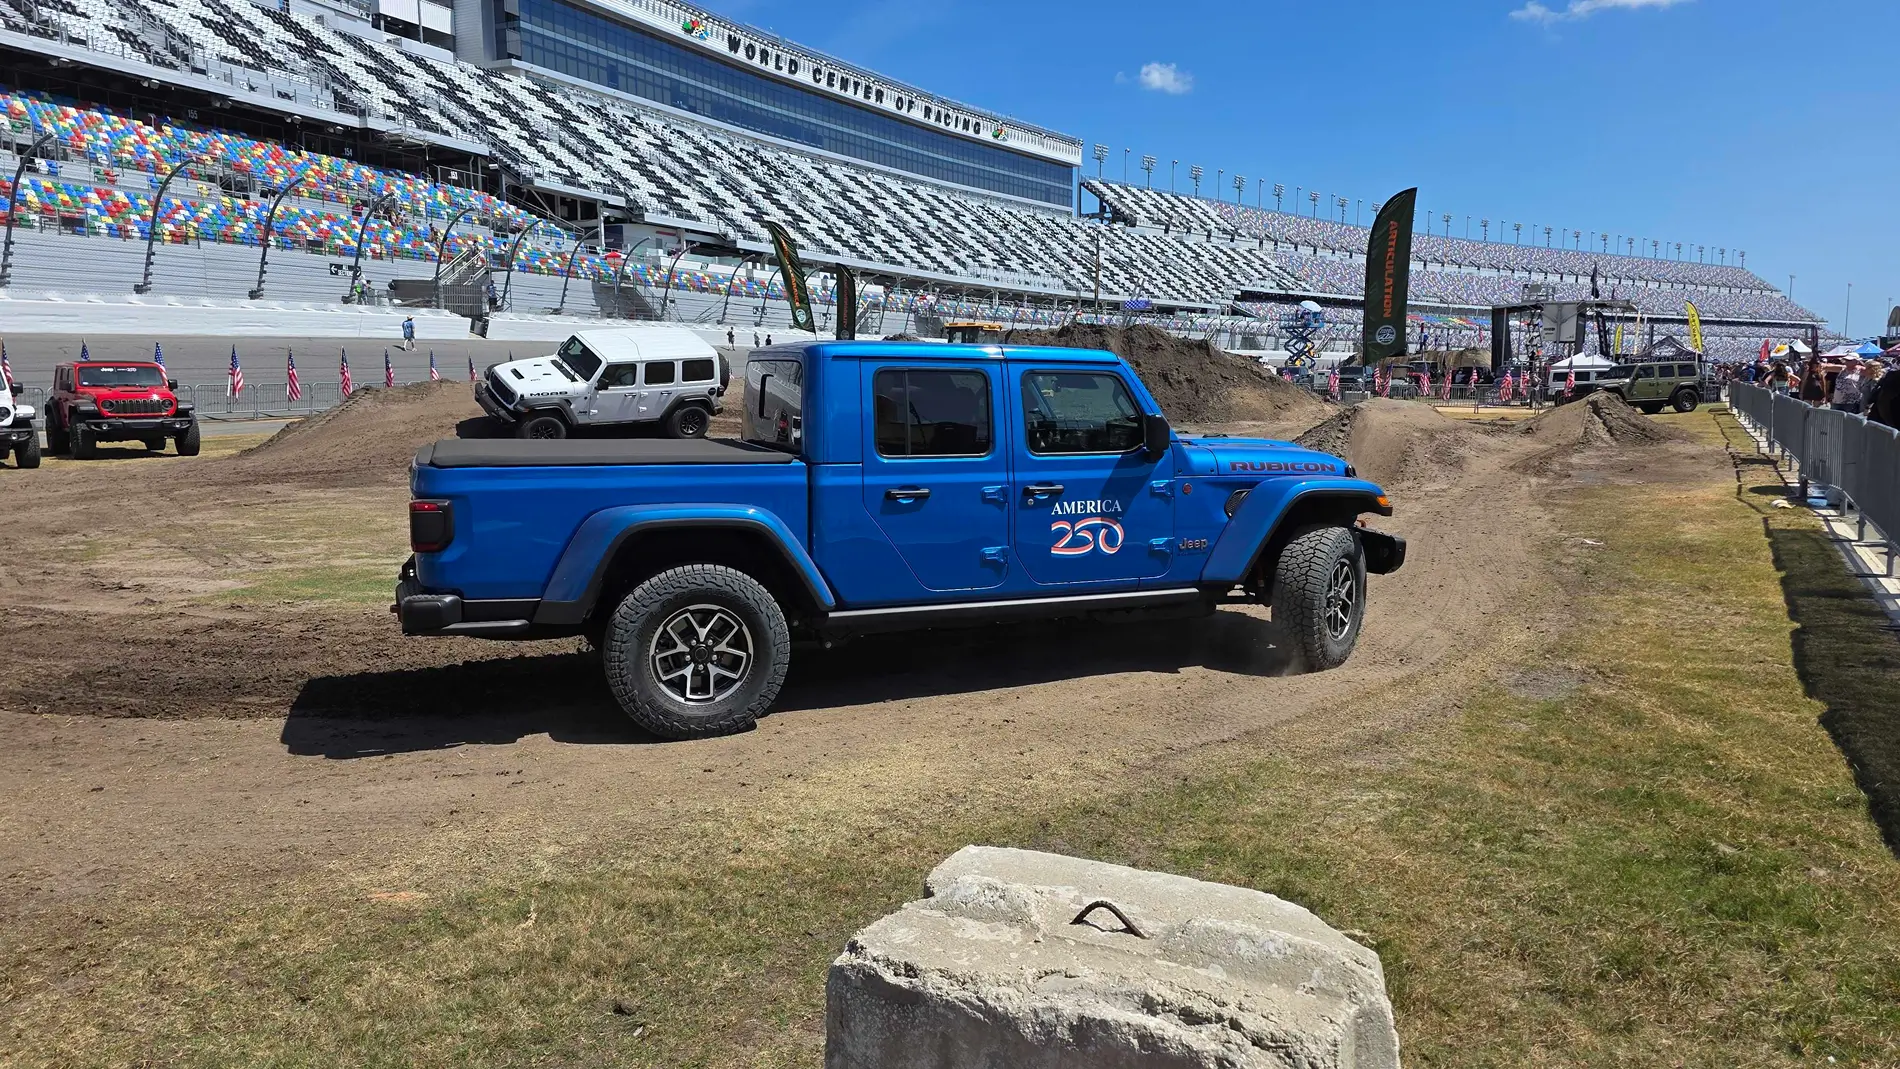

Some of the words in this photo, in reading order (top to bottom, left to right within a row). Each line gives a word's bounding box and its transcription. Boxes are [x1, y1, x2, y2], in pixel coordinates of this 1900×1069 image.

[728, 34, 799, 75] WORLD
[812, 66, 884, 104] CENTER
[895, 96, 915, 113] OF
[923, 106, 982, 135] RACING
[187, 109, 198, 120] 155
[1383, 220, 1399, 317] ARTICULATION
[1229, 461, 1336, 473] RUBICON
[1051, 499, 1123, 515] AMERICA
[1051, 517, 1125, 555] 250
[1178, 537, 1208, 550] Jeep
